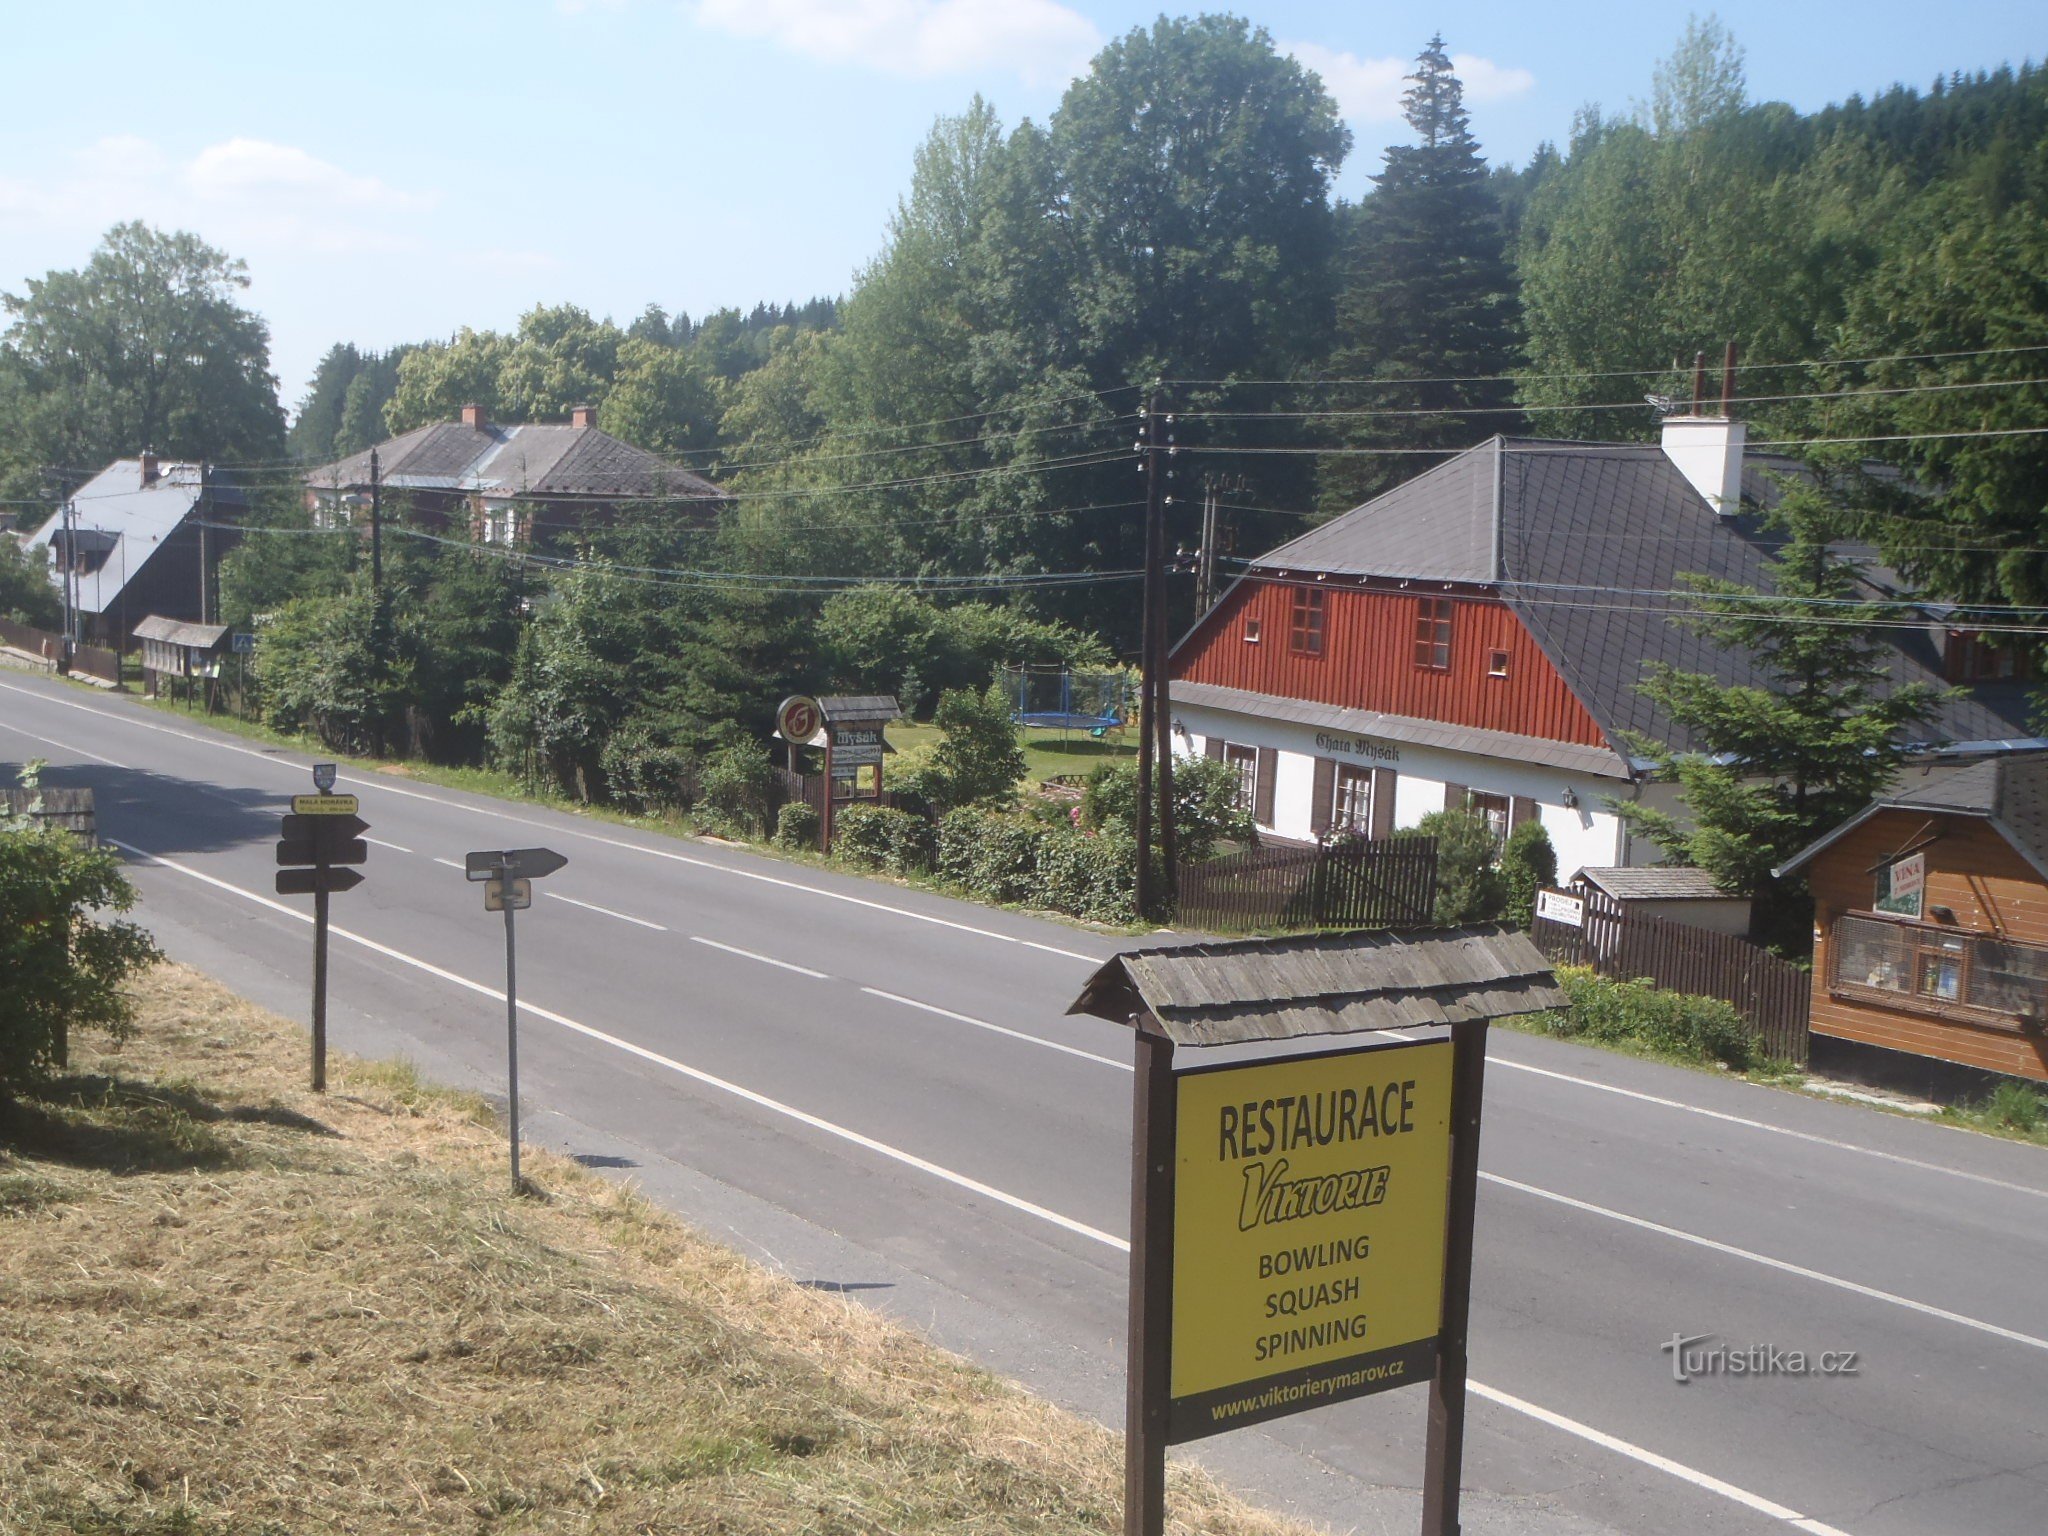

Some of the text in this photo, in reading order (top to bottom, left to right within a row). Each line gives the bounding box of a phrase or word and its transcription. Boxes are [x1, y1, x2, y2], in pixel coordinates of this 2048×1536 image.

[1315, 732, 1351, 753] Chata
[1219, 1080, 1416, 1162] RESTAURACE
[1258, 1235, 1370, 1280] BOWLING
[1265, 1276, 1360, 1319] SQUASH
[1254, 1314, 1368, 1362] SPINNING
[1211, 1360, 1405, 1421] www.viktorierymarov.cz
